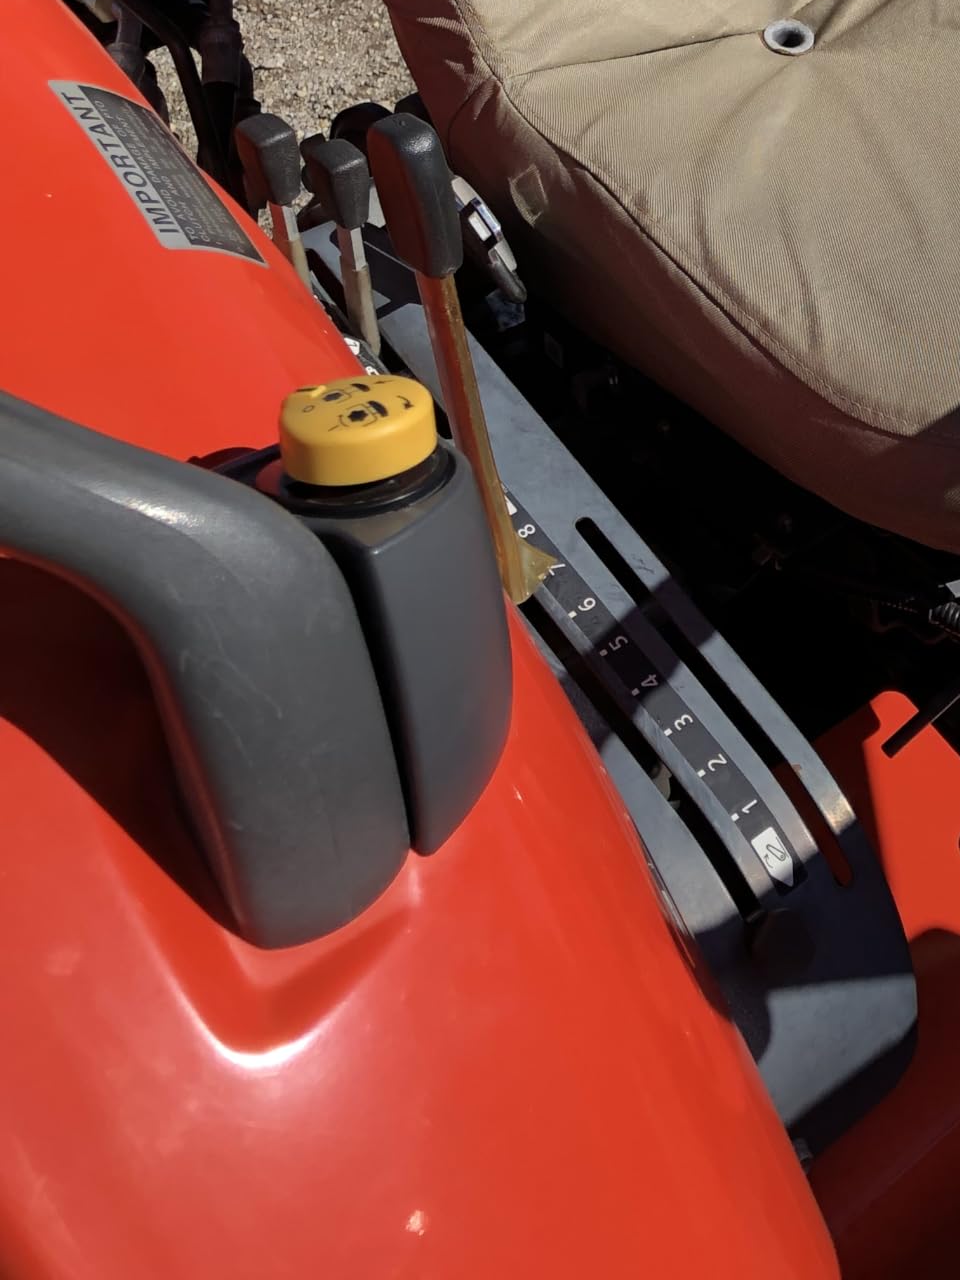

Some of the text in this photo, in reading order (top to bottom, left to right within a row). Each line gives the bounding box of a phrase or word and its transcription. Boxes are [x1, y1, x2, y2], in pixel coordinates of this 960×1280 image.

[61, 91, 180, 234] IMPORTANT
[517, 524, 536, 538] 8
[608, 635, 629, 651] 5
[641, 674, 659, 688] 4
[673, 713, 694, 731] 3
[707, 753, 728, 772] 2
[741, 799, 758, 814] 1
